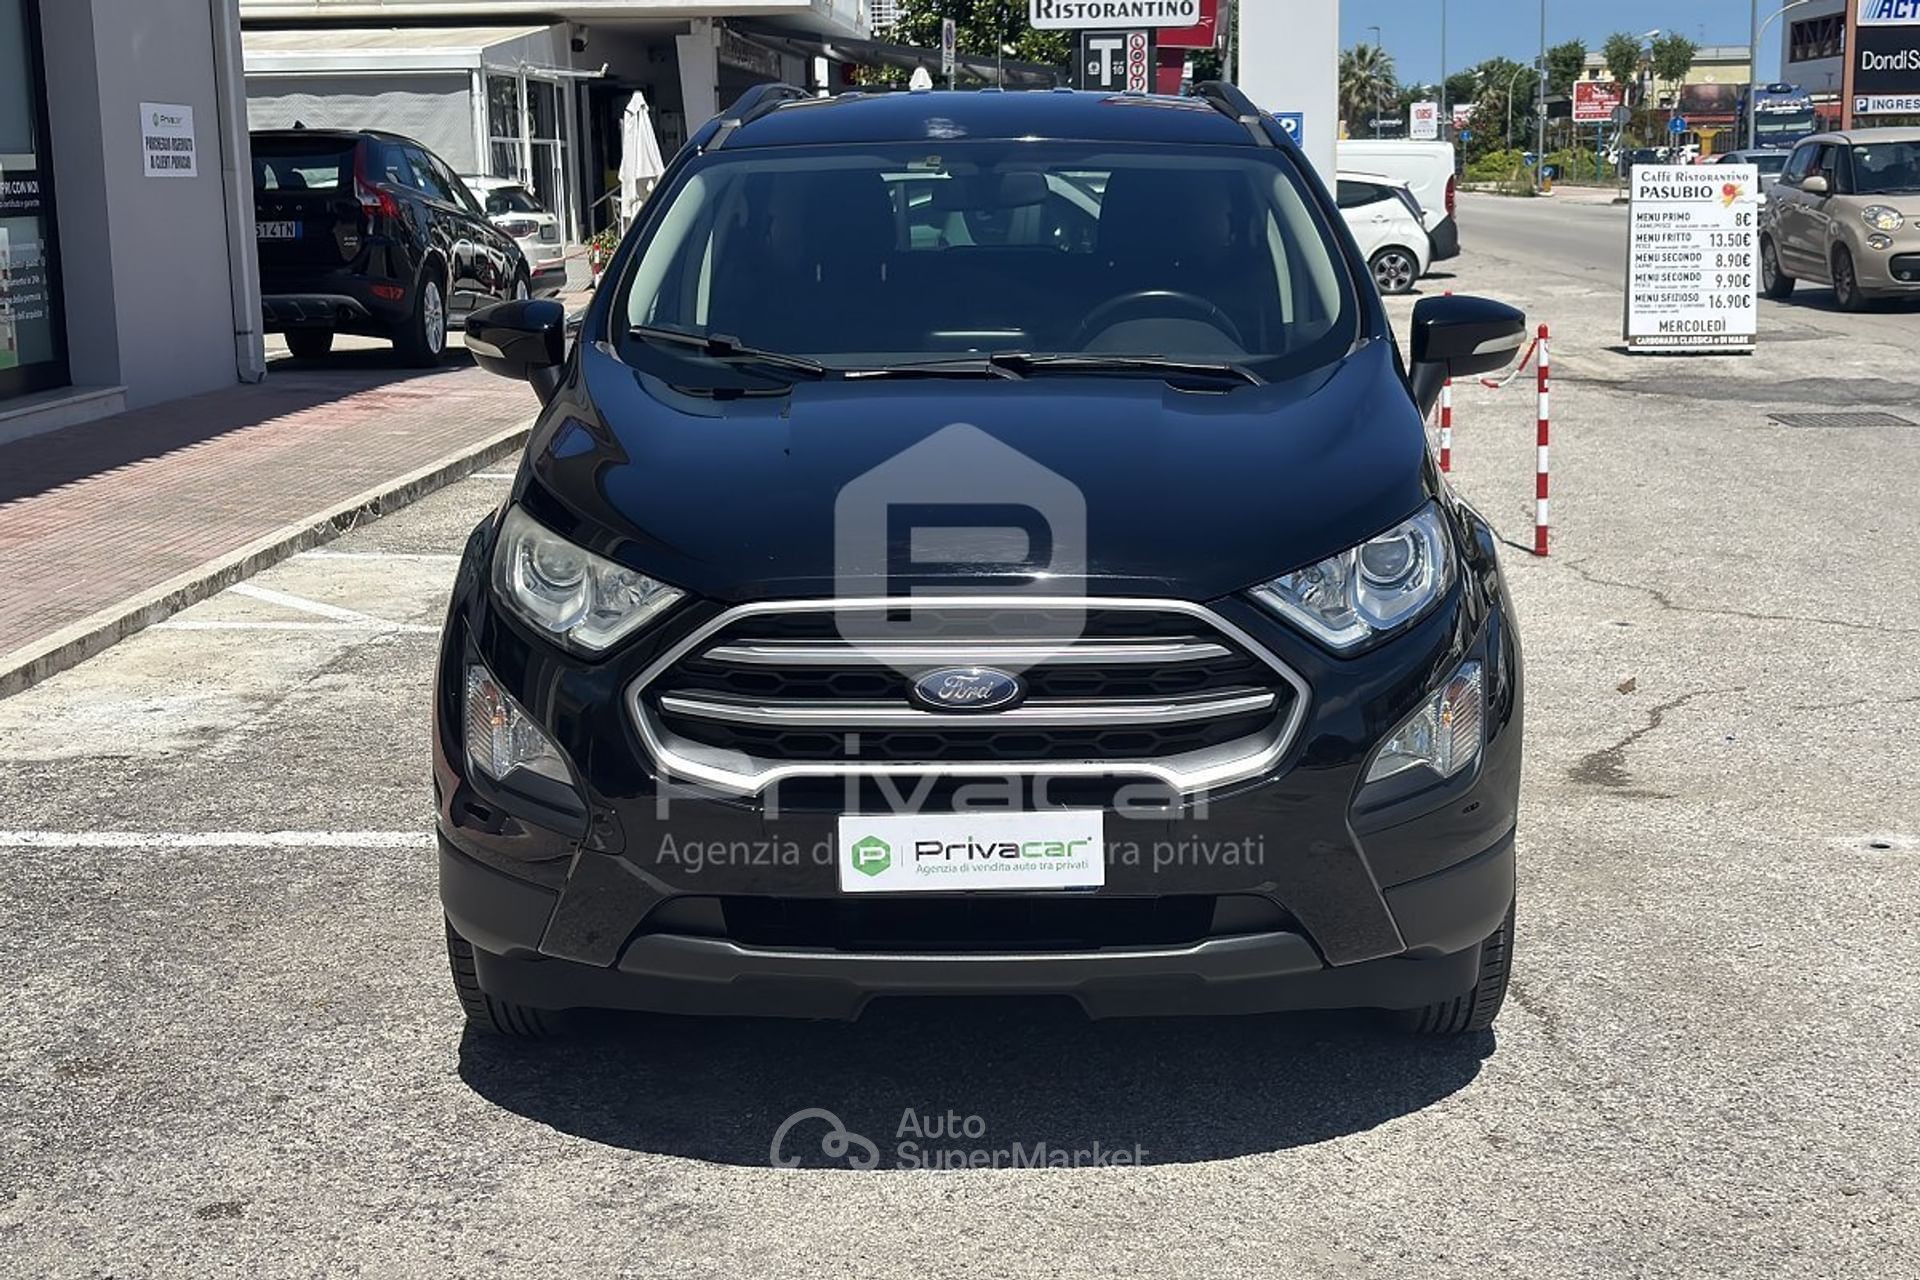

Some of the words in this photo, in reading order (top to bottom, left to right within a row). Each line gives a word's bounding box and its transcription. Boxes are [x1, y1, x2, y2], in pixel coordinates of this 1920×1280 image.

[1035, 0, 1193, 19] RISTORANTINO
[1089, 39, 1123, 86] T
[1861, 50, 1920, 70] DondiS
[1640, 185, 1713, 199] PASUBIO
[1636, 212, 1661, 222] MENU
[1662, 212, 1691, 221] PRIMO
[1735, 212, 1752, 227] 8€
[1636, 232, 1661, 242] MENU
[1662, 232, 1692, 242] FRITTO
[1709, 233, 1752, 248] 13.50€
[1635, 253, 1660, 262] MENU
[1662, 252, 1703, 262] SECONDO
[1715, 253, 1751, 268] 8.90€
[1635, 273, 1660, 282] MENU
[1661, 272, 1702, 282] SECONDO
[1715, 273, 1751, 288] 9.90€
[1634, 294, 1660, 303] MENU
[1661, 293, 1700, 303] SFIZIOSO
[1709, 294, 1751, 309] 16.90€
[1659, 316, 1727, 333] MERCOLEDÌ
[938, 675, 995, 699] Ford
[915, 836, 1092, 862] Privacar
[916, 863, 958, 877] Agenzia
[959, 861, 970, 873] di
[971, 862, 1011, 873] vendita
[1012, 862, 1037, 872] auto
[1039, 861, 1055, 871] tra
[1055, 859, 1089, 871] privati
